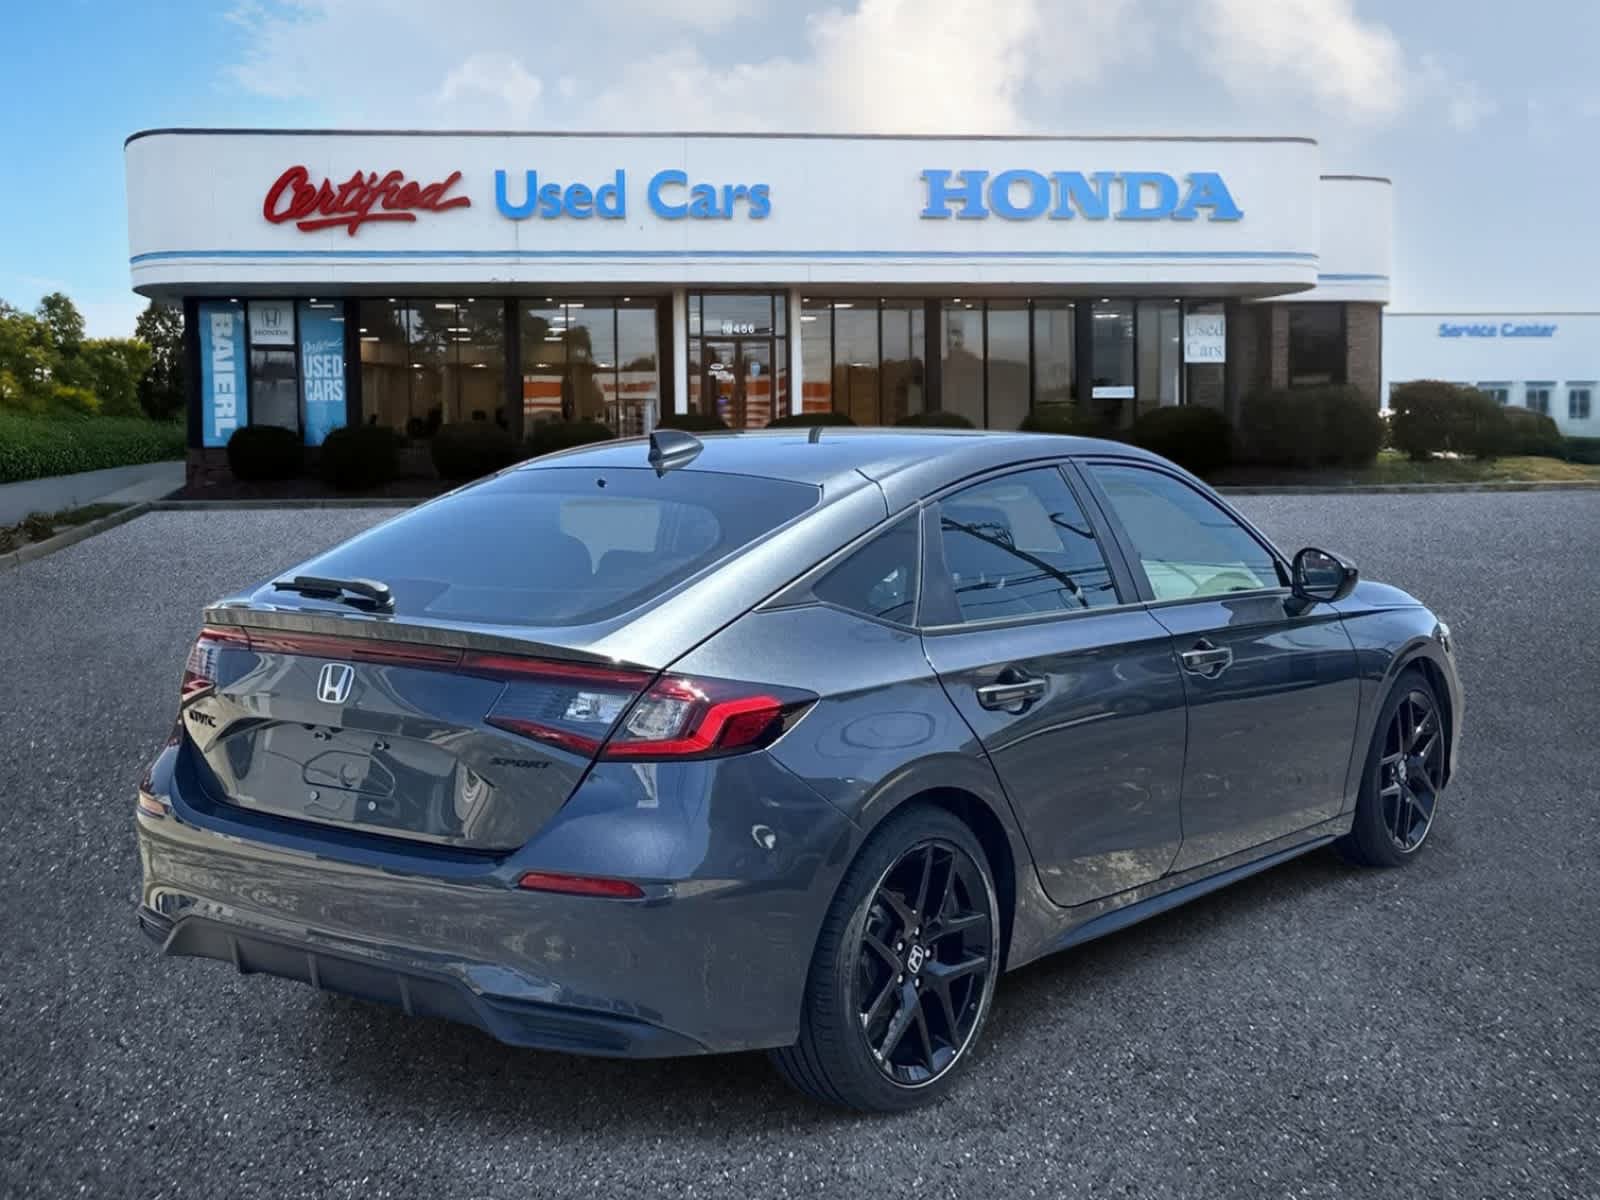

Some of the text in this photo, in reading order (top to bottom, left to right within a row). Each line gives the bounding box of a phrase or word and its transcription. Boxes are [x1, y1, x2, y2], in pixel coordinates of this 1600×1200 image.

[264, 166, 772, 235] Certified Used Cars
[920, 169, 1244, 221] HONDA
[1186, 319, 1225, 337] Used
[211, 313, 237, 437] BAIERL
[303, 354, 343, 378] USED
[304, 379, 344, 401] CARS
[490, 757, 552, 769] SPORT
